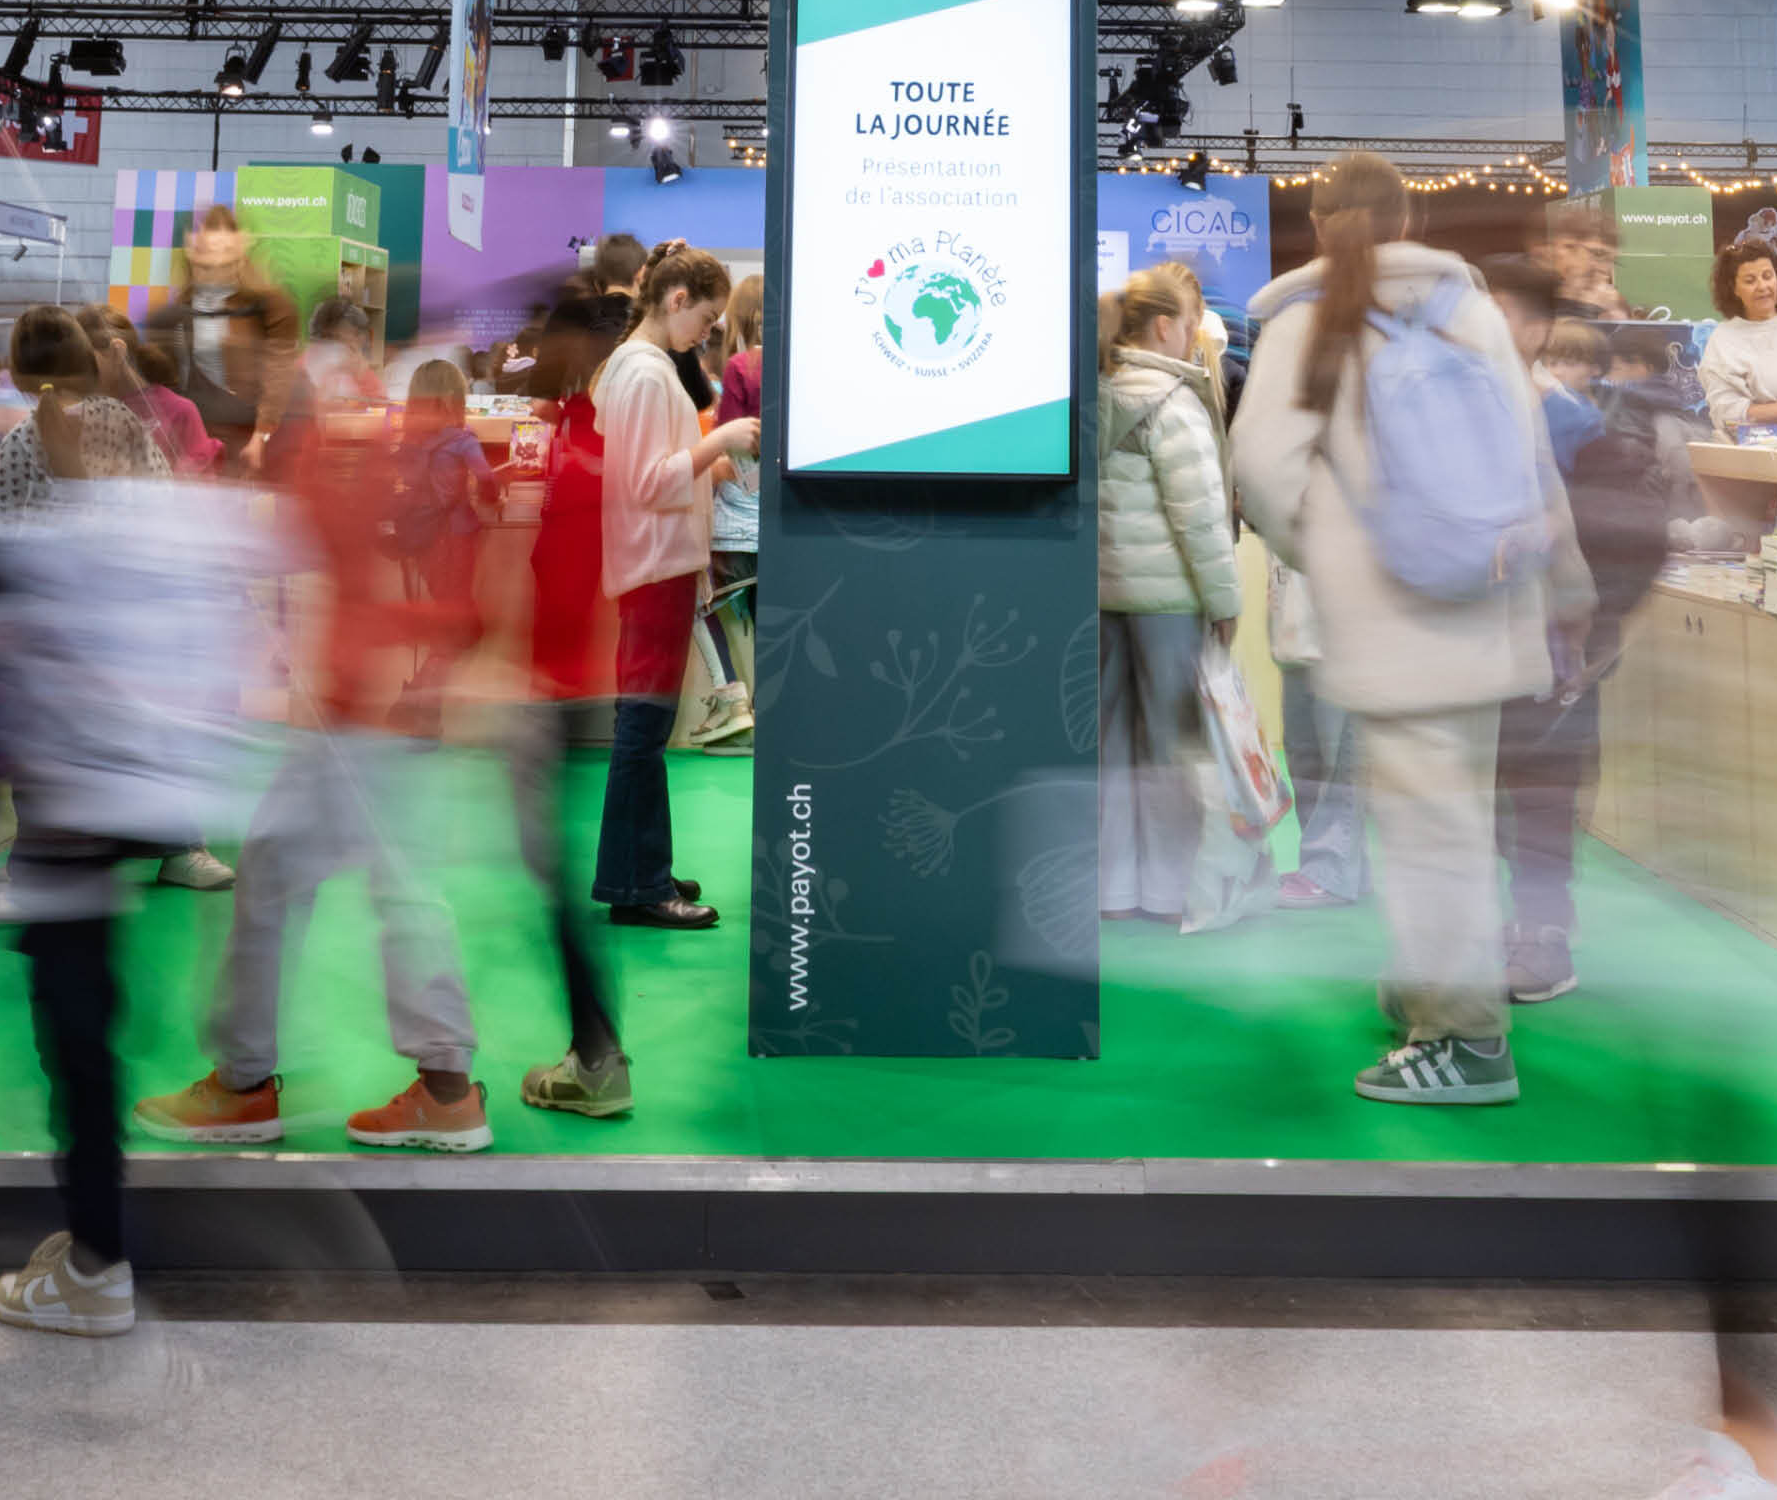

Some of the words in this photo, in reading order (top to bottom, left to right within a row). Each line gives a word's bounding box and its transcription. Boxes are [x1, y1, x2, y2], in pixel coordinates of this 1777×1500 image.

[890, 81, 974, 102] TOUTE
[856, 113, 886, 134] LA
[891, 108, 1009, 140] JOURNÉE
[862, 157, 1001, 177] Présentation
[242, 195, 326, 208] www.payot.ch
[846, 186, 871, 205] de
[880, 186, 1018, 205] l'association
[1151, 209, 1250, 234] CICAD
[1622, 213, 1707, 226] www.payot.ch
[888, 237, 925, 263] ma
[914, 367, 948, 377] SUISSE
[958, 332, 993, 370] SVIZZERA
[786, 783, 816, 1011] www.payot.ch
